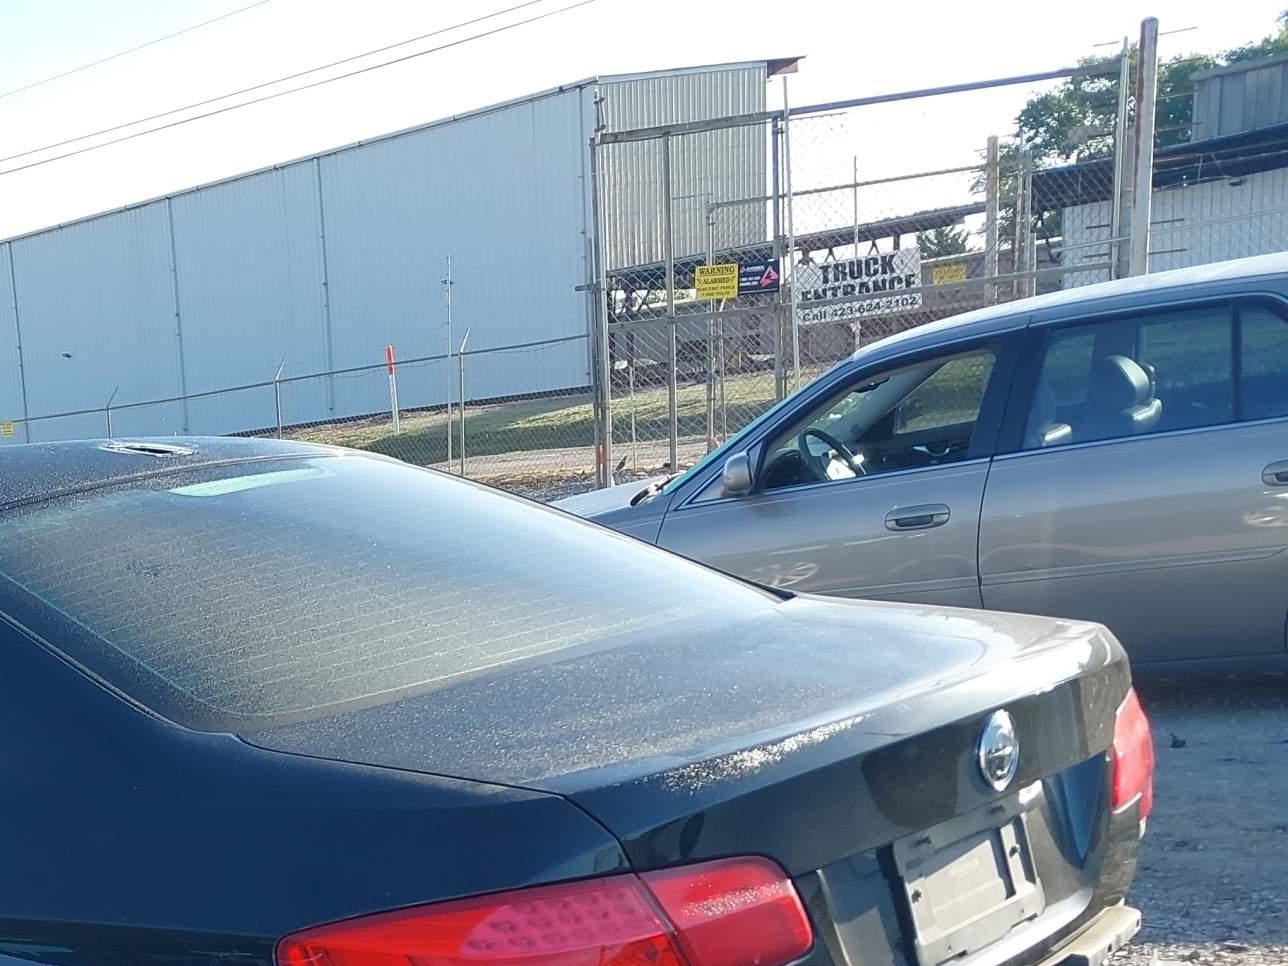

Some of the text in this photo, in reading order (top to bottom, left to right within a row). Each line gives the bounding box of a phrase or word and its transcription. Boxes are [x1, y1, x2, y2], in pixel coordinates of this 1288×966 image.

[699, 265, 735, 275] WARNING
[819, 254, 896, 284] TRUCK
[801, 273, 916, 302] ENTRANCE
[802, 296, 917, 322] Call 423-624-2102
